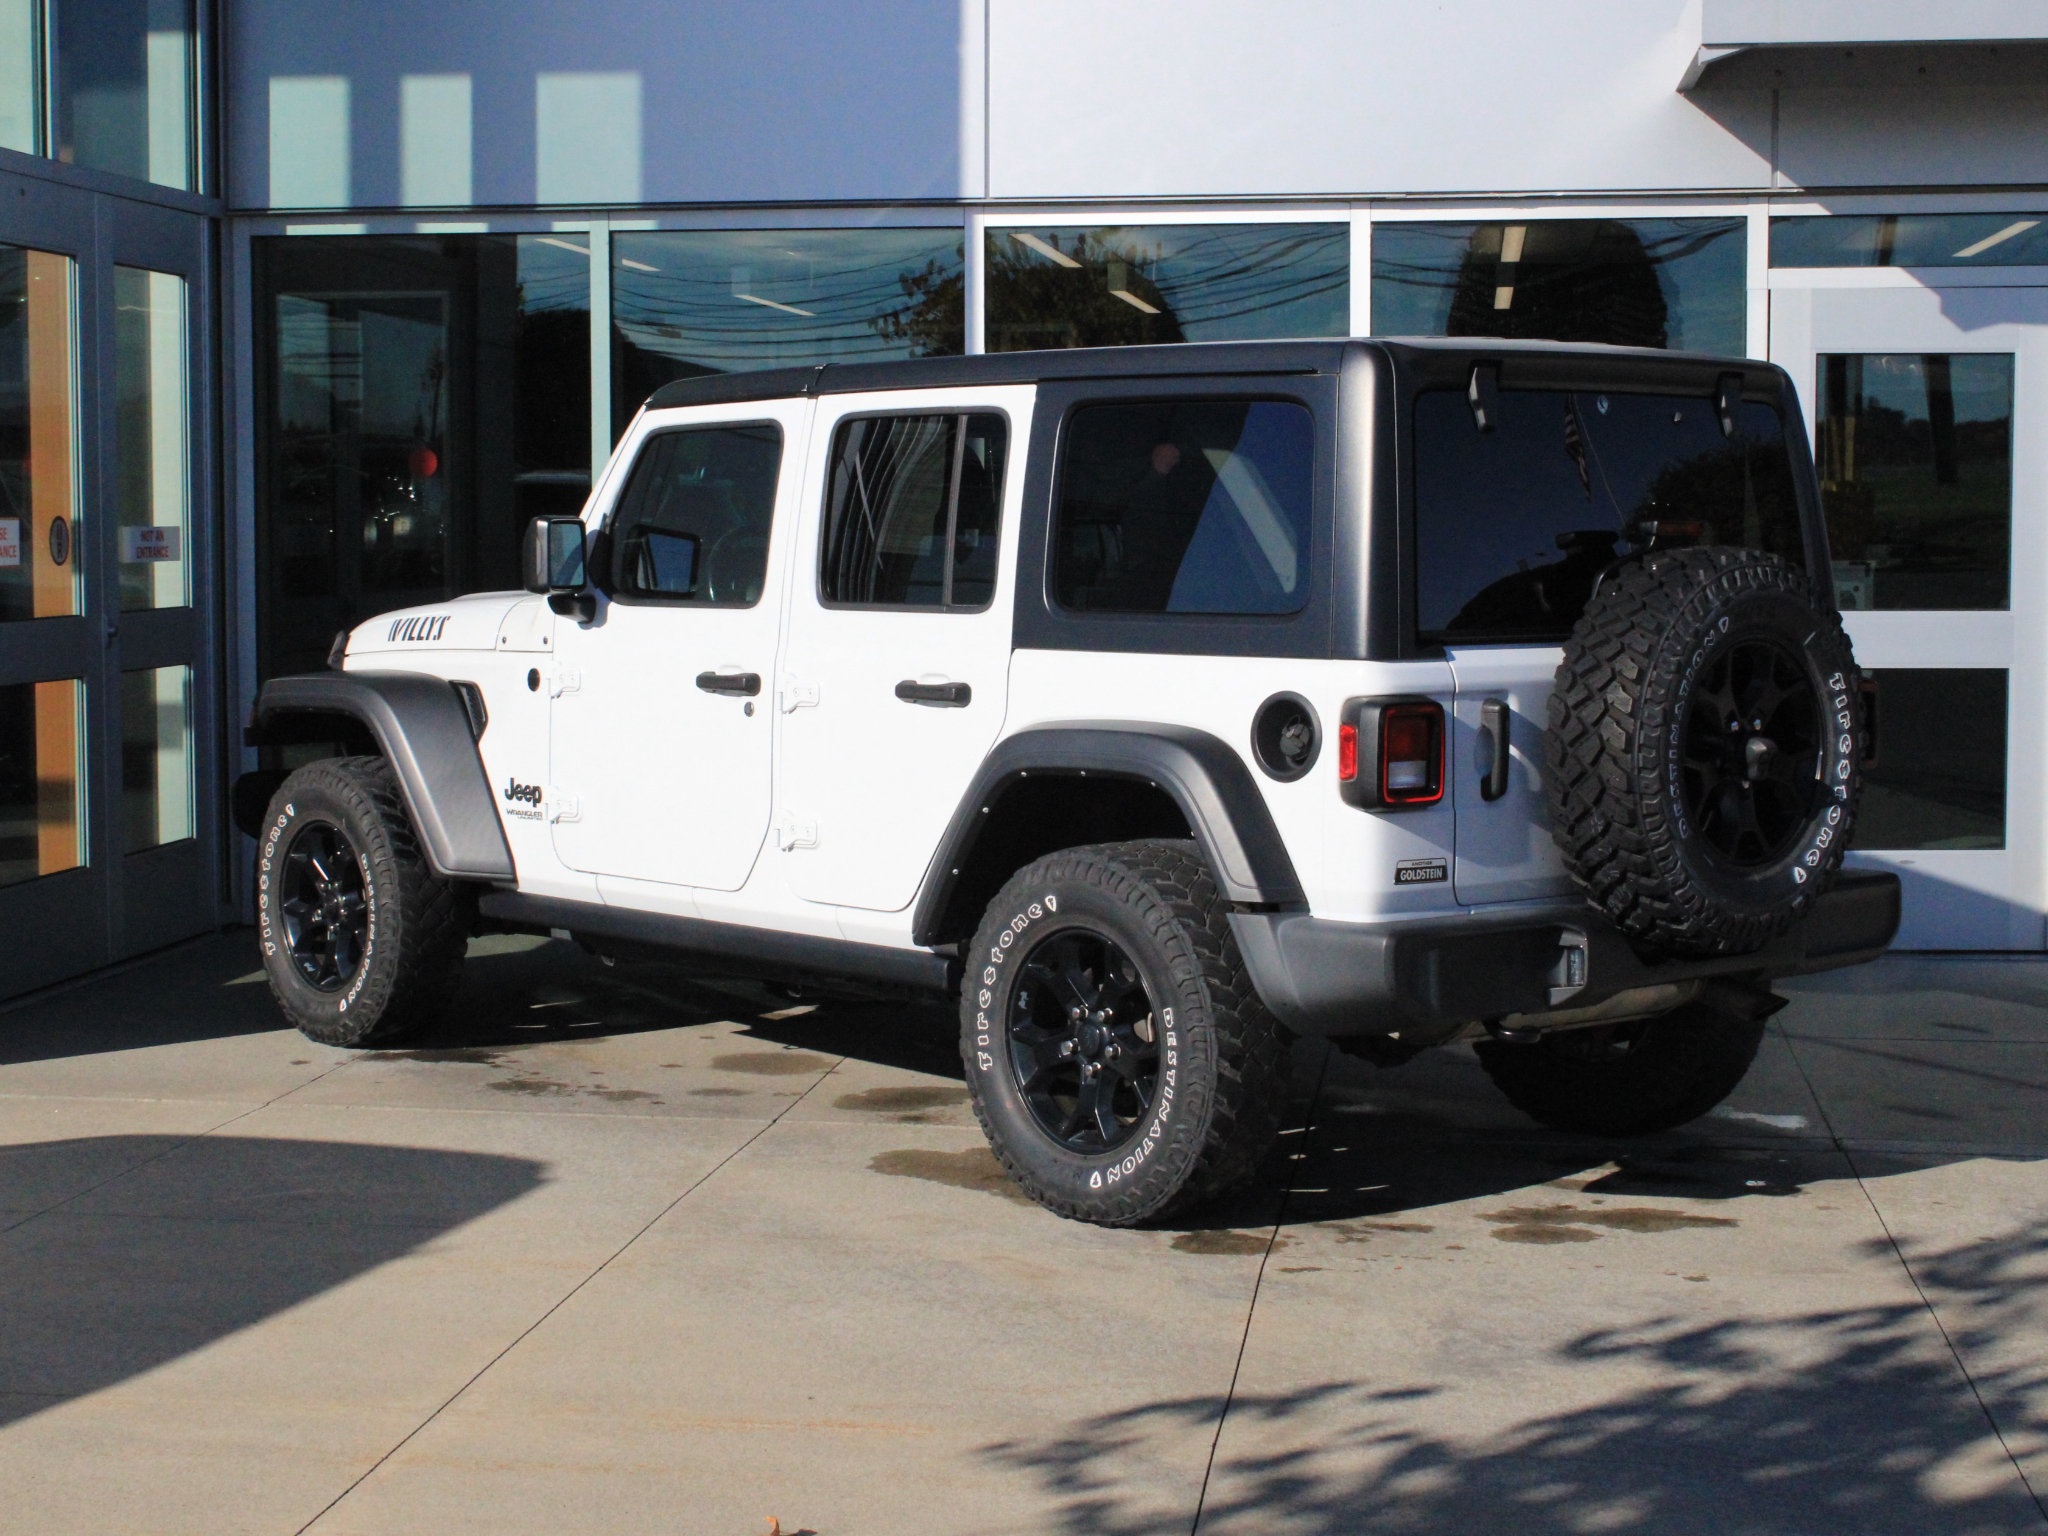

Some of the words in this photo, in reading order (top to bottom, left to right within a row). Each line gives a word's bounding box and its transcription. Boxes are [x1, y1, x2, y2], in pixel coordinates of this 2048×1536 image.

[140, 530, 153, 542] NOT
[156, 530, 165, 542] AN
[136, 545, 169, 559] ENTRANCE
[387, 615, 452, 642] WILLYS
[504, 777, 542, 808] Jeep
[506, 808, 543, 817] WRANGLER
[259, 814, 289, 956] Firestone
[1400, 867, 1443, 881] GOLDSTEIN
[976, 901, 1044, 1072] Firestone
[1106, 1007, 1179, 1186] DESTINATION
